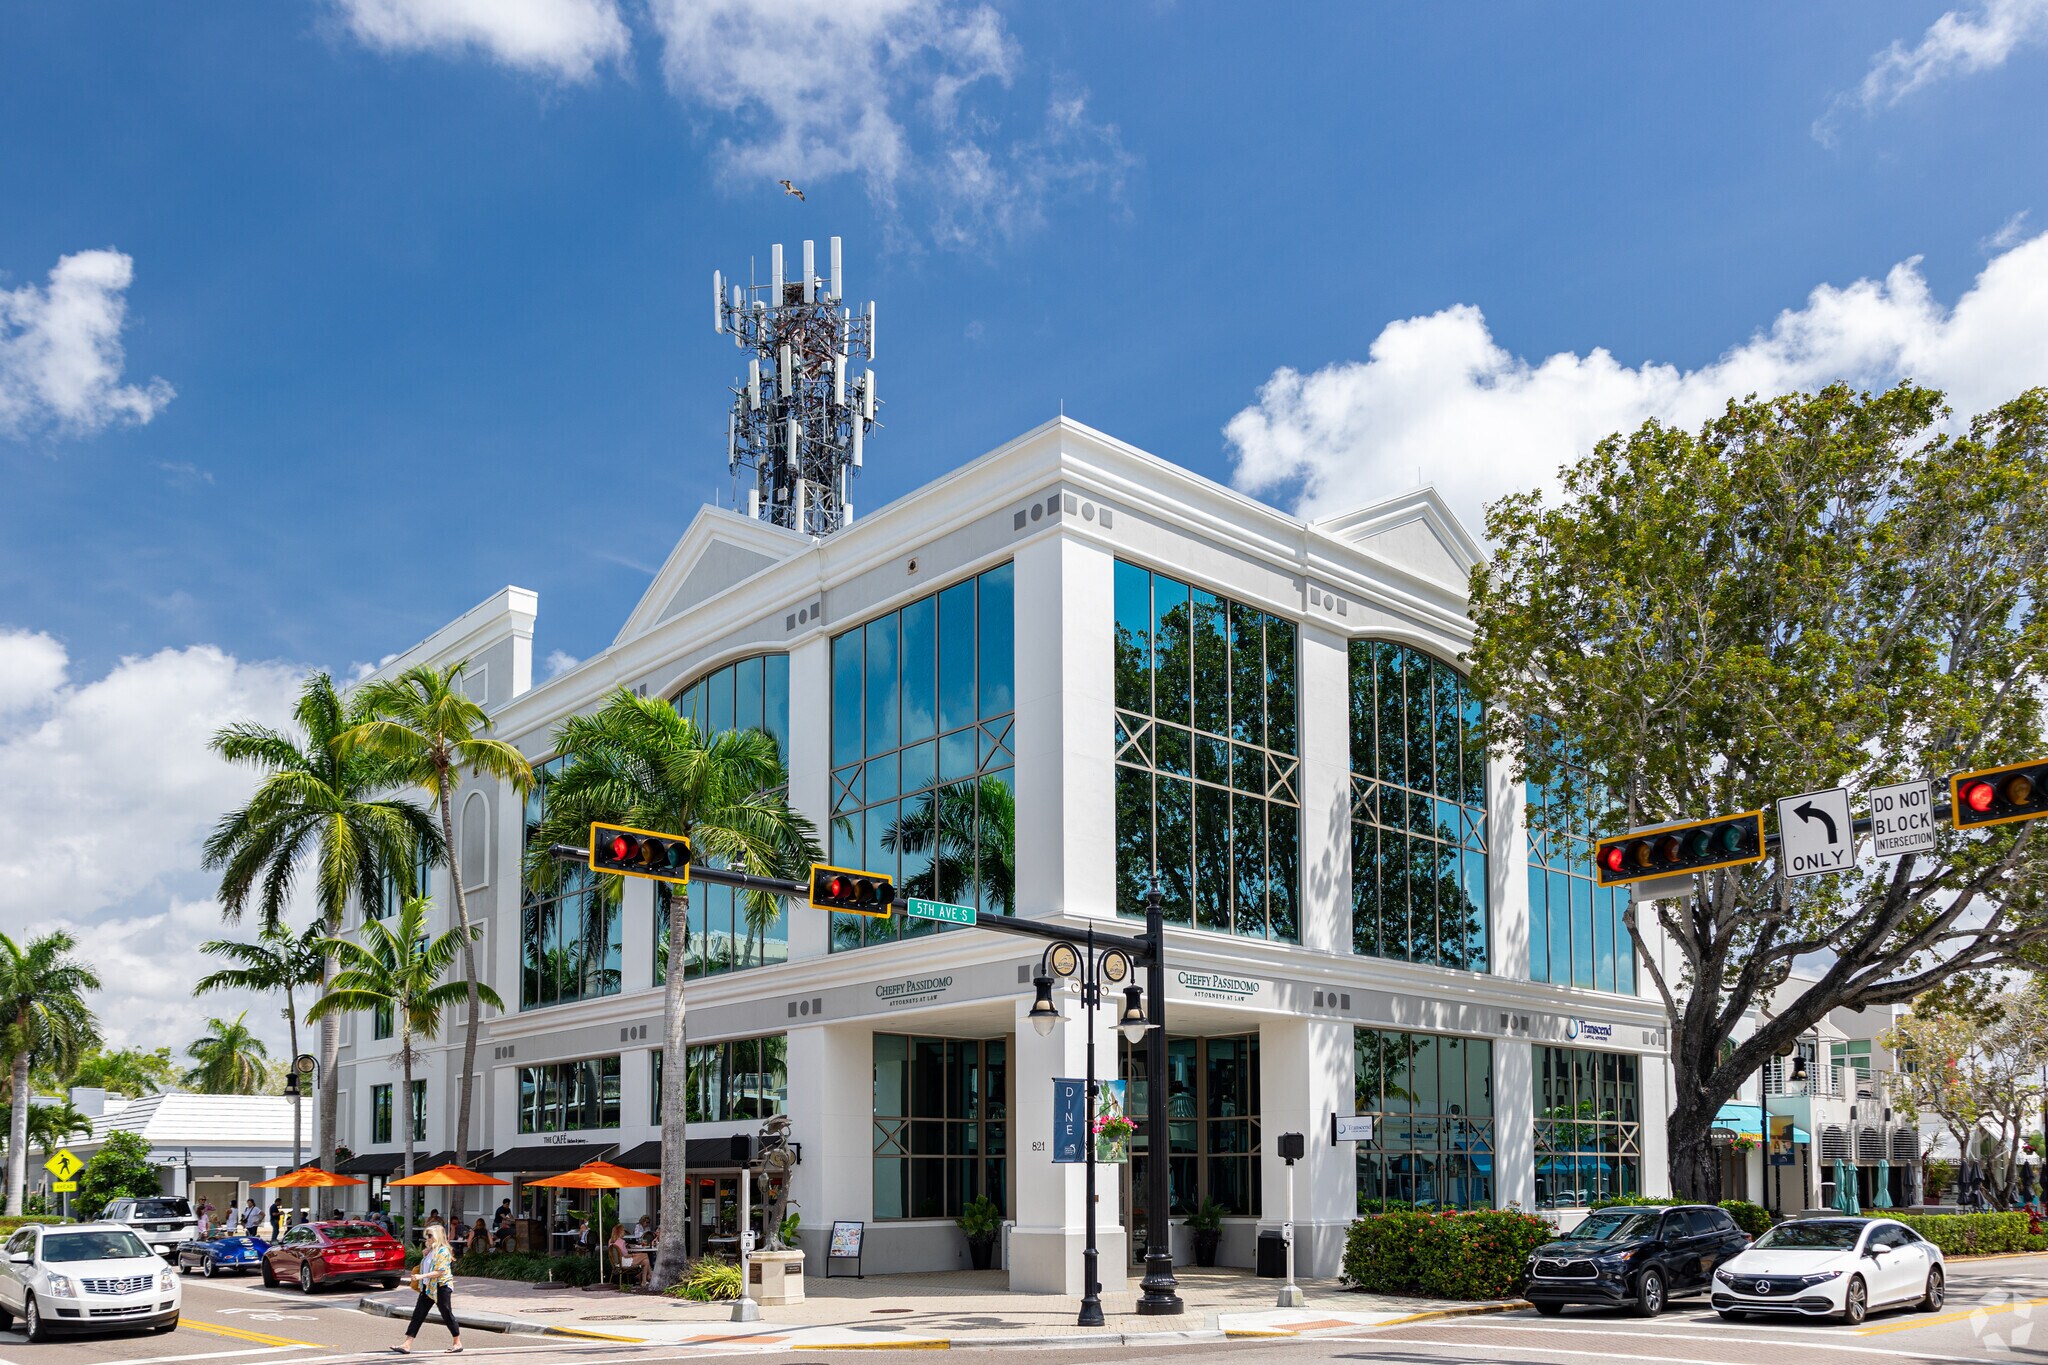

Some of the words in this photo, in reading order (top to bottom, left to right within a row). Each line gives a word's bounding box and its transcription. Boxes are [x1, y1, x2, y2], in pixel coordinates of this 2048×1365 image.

[1874, 795, 1894, 813] DO
[1900, 789, 1927, 808] NOT
[1876, 812, 1931, 835] BLOCK
[1877, 832, 1933, 850] INTERSECTION
[1793, 849, 1844, 871] ONLY
[917, 902, 934, 916] 5TH
[939, 905, 958, 920] AVE
[961, 909, 968, 922] S
[889, 998, 918, 1007] ATTORNEYS
[927, 994, 938, 1002] LAW
[1194, 991, 1225, 1000] ATTORNEYS
[1579, 1020, 1612, 1036] Transcend
[1065, 1086, 1074, 1136] DINE
[543, 1136, 552, 1144] THE
[552, 1132, 567, 1145] CAFÉ
[1031, 1141, 1045, 1151] 821
